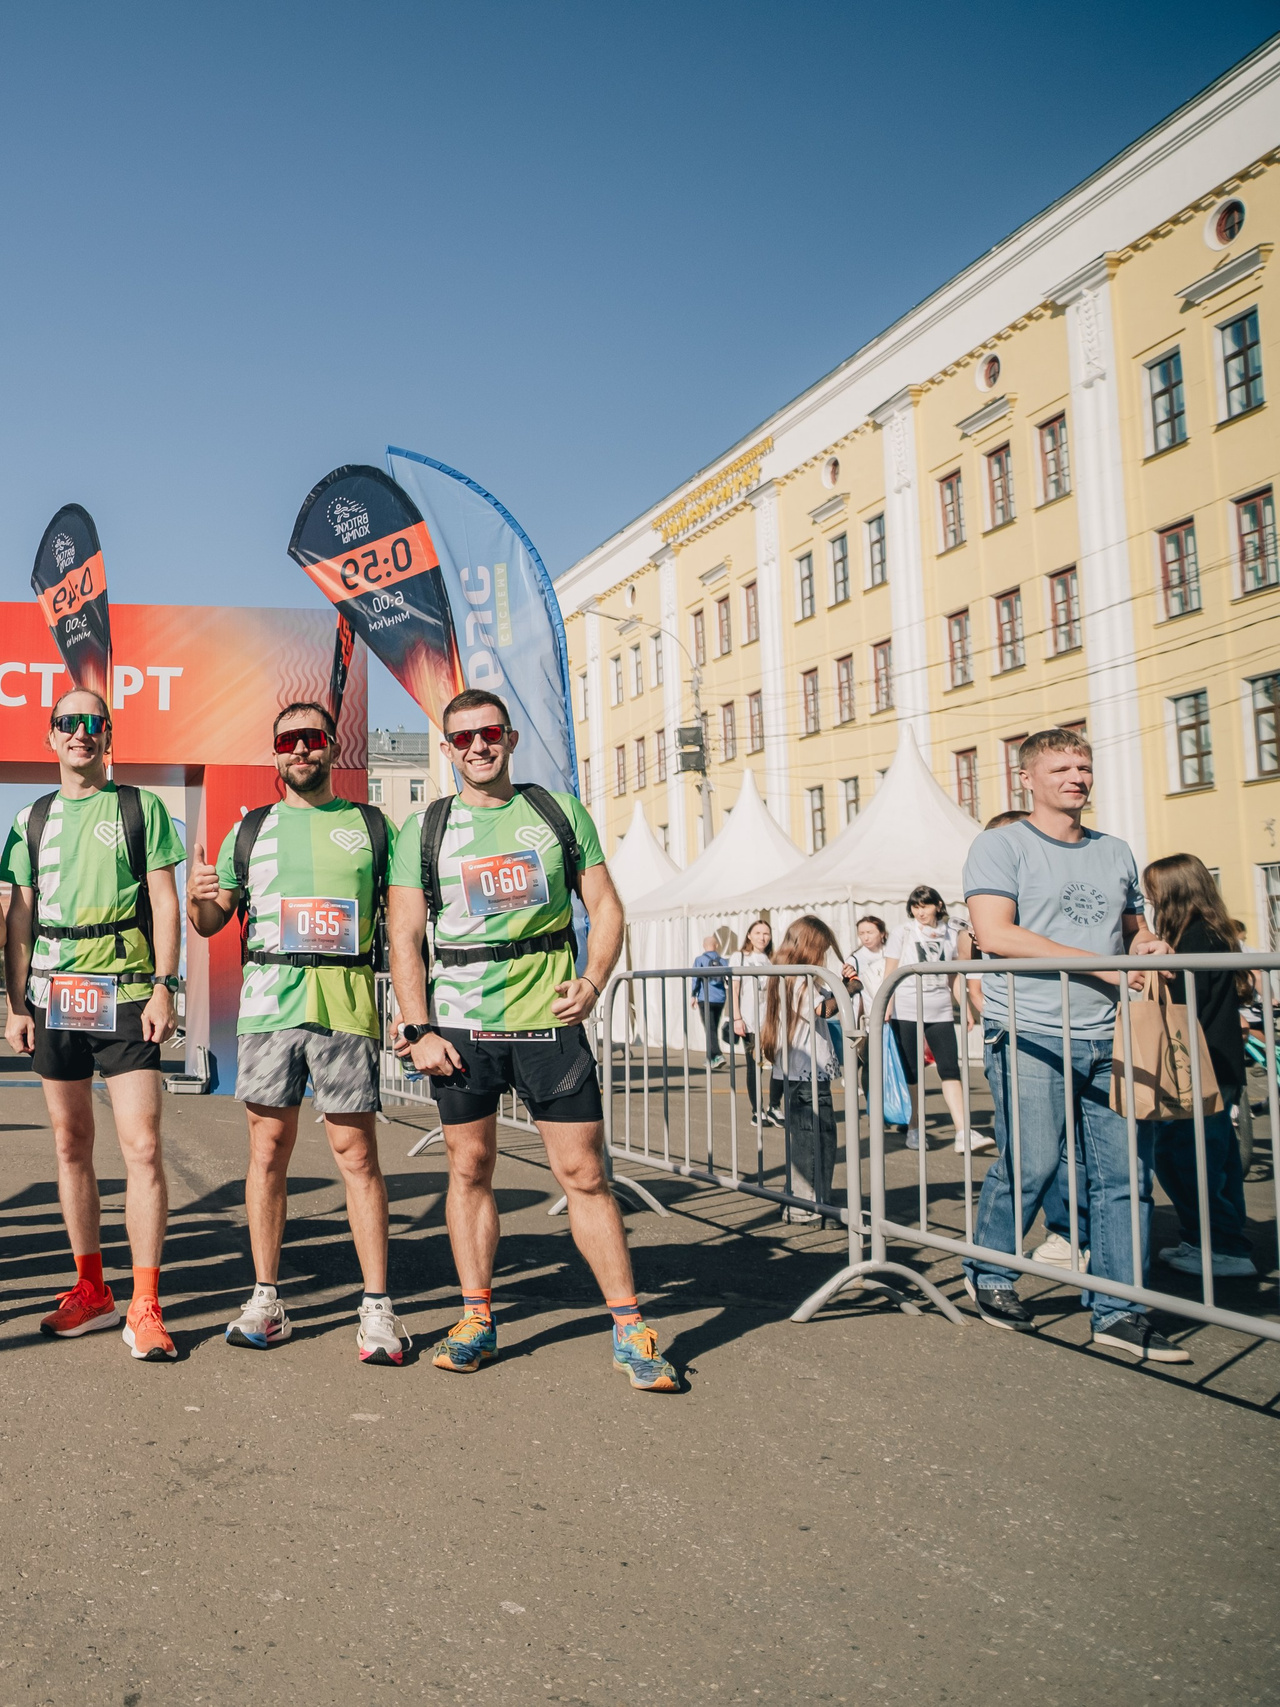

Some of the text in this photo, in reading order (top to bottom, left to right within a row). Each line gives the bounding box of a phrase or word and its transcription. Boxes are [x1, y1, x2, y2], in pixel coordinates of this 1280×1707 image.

[479, 865, 528, 897] 0:60
[1063, 884, 1106, 906] BALTIC SEA
[297, 910, 340, 936] 0:55
[1064, 906, 1105, 925] BLACK SEA
[60, 988, 98, 1013] 0:50
